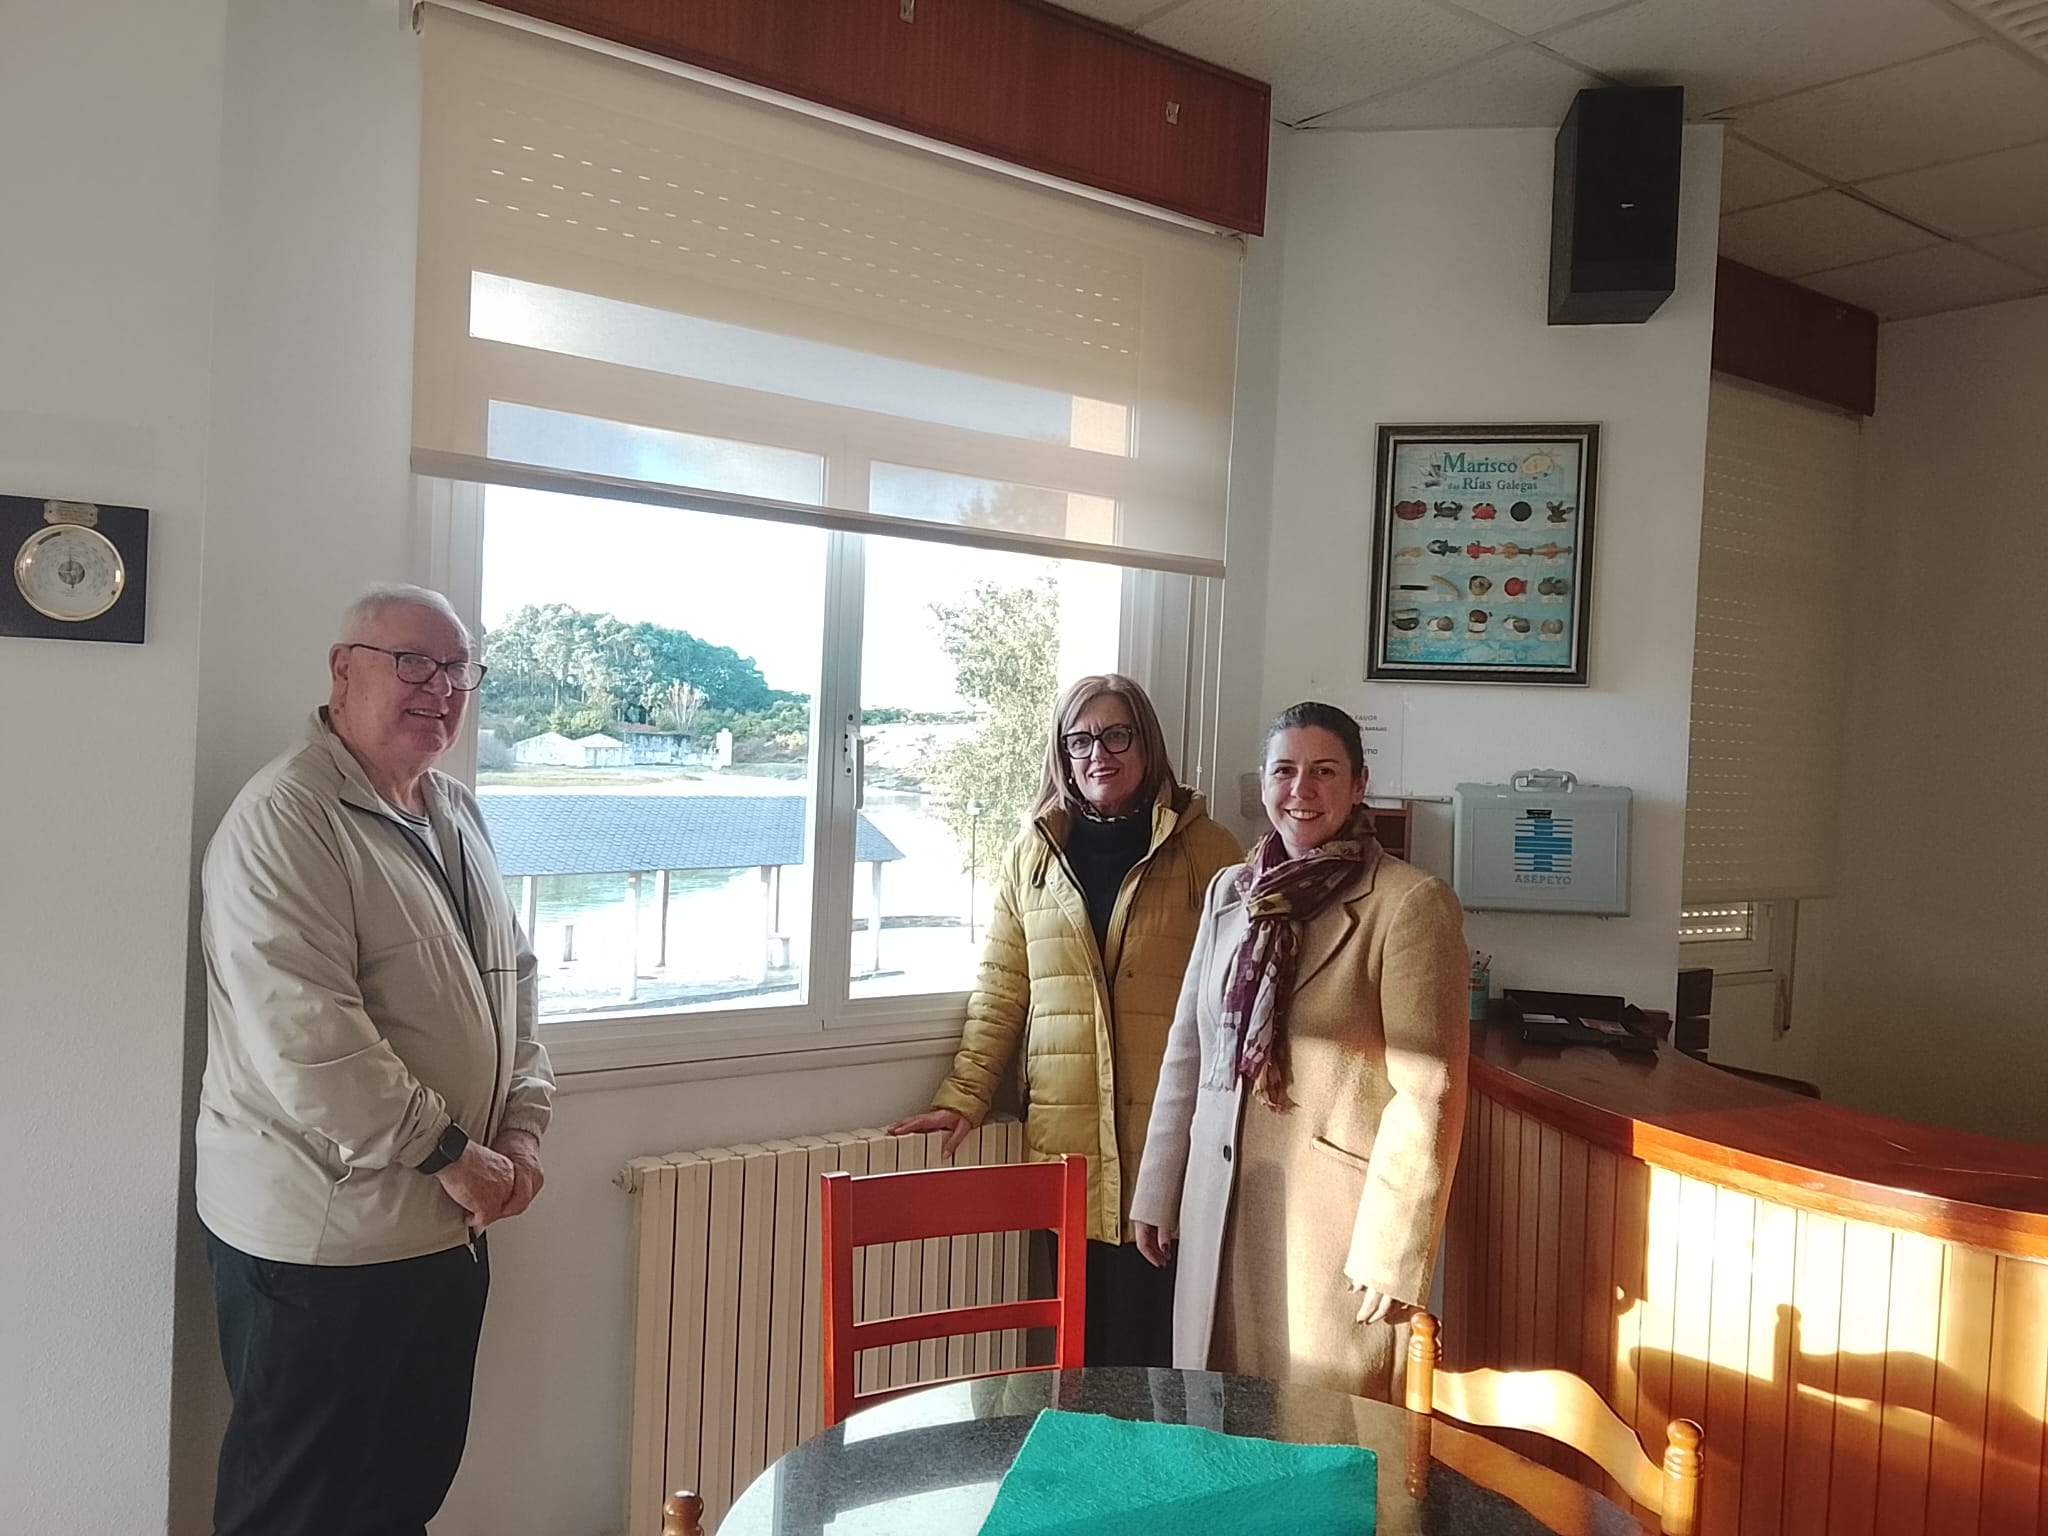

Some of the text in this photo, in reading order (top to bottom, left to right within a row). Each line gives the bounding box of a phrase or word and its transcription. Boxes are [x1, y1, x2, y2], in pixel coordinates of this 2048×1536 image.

[1443, 452, 1518, 473] Marisco
[1462, 477, 1492, 490] Rías
[1497, 480, 1538, 493] Galegas
[1514, 874, 1572, 885] ASEPEYO
